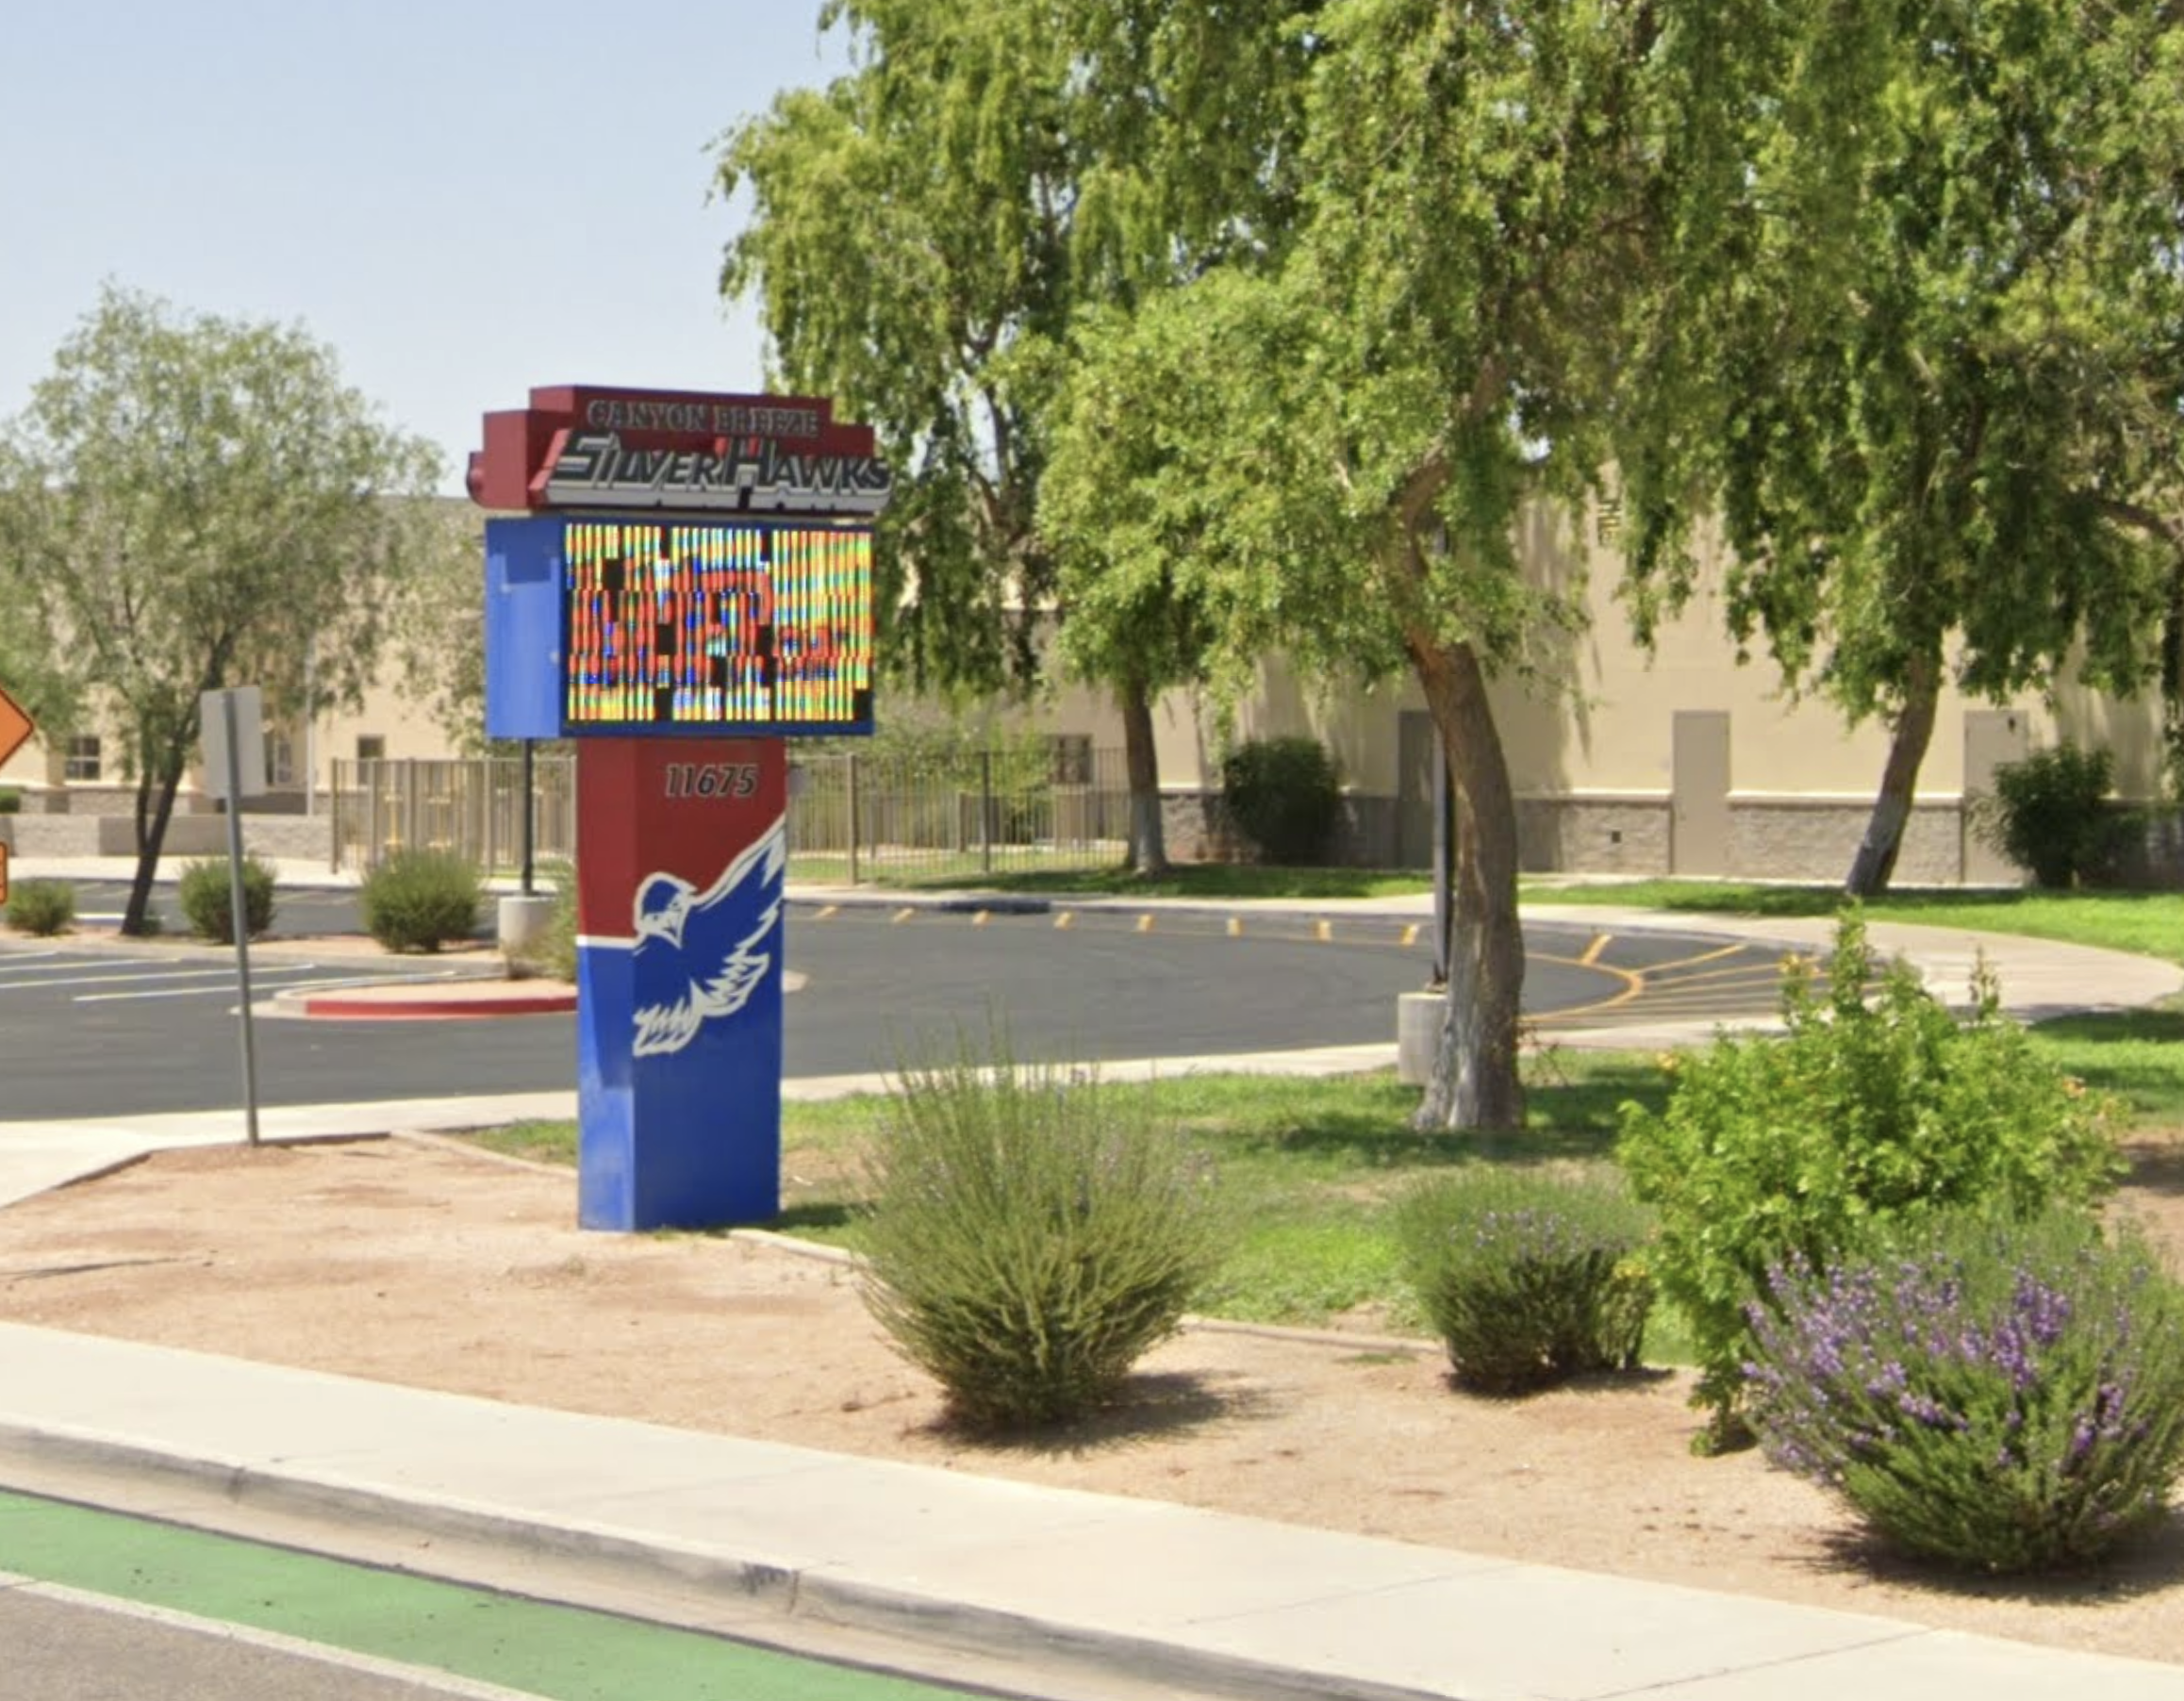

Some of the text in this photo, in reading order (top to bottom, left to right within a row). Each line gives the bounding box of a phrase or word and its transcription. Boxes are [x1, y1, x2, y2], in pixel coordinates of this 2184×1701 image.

[586, 398, 819, 438] CANYON BREEZE
[664, 763, 758, 797] 11675
